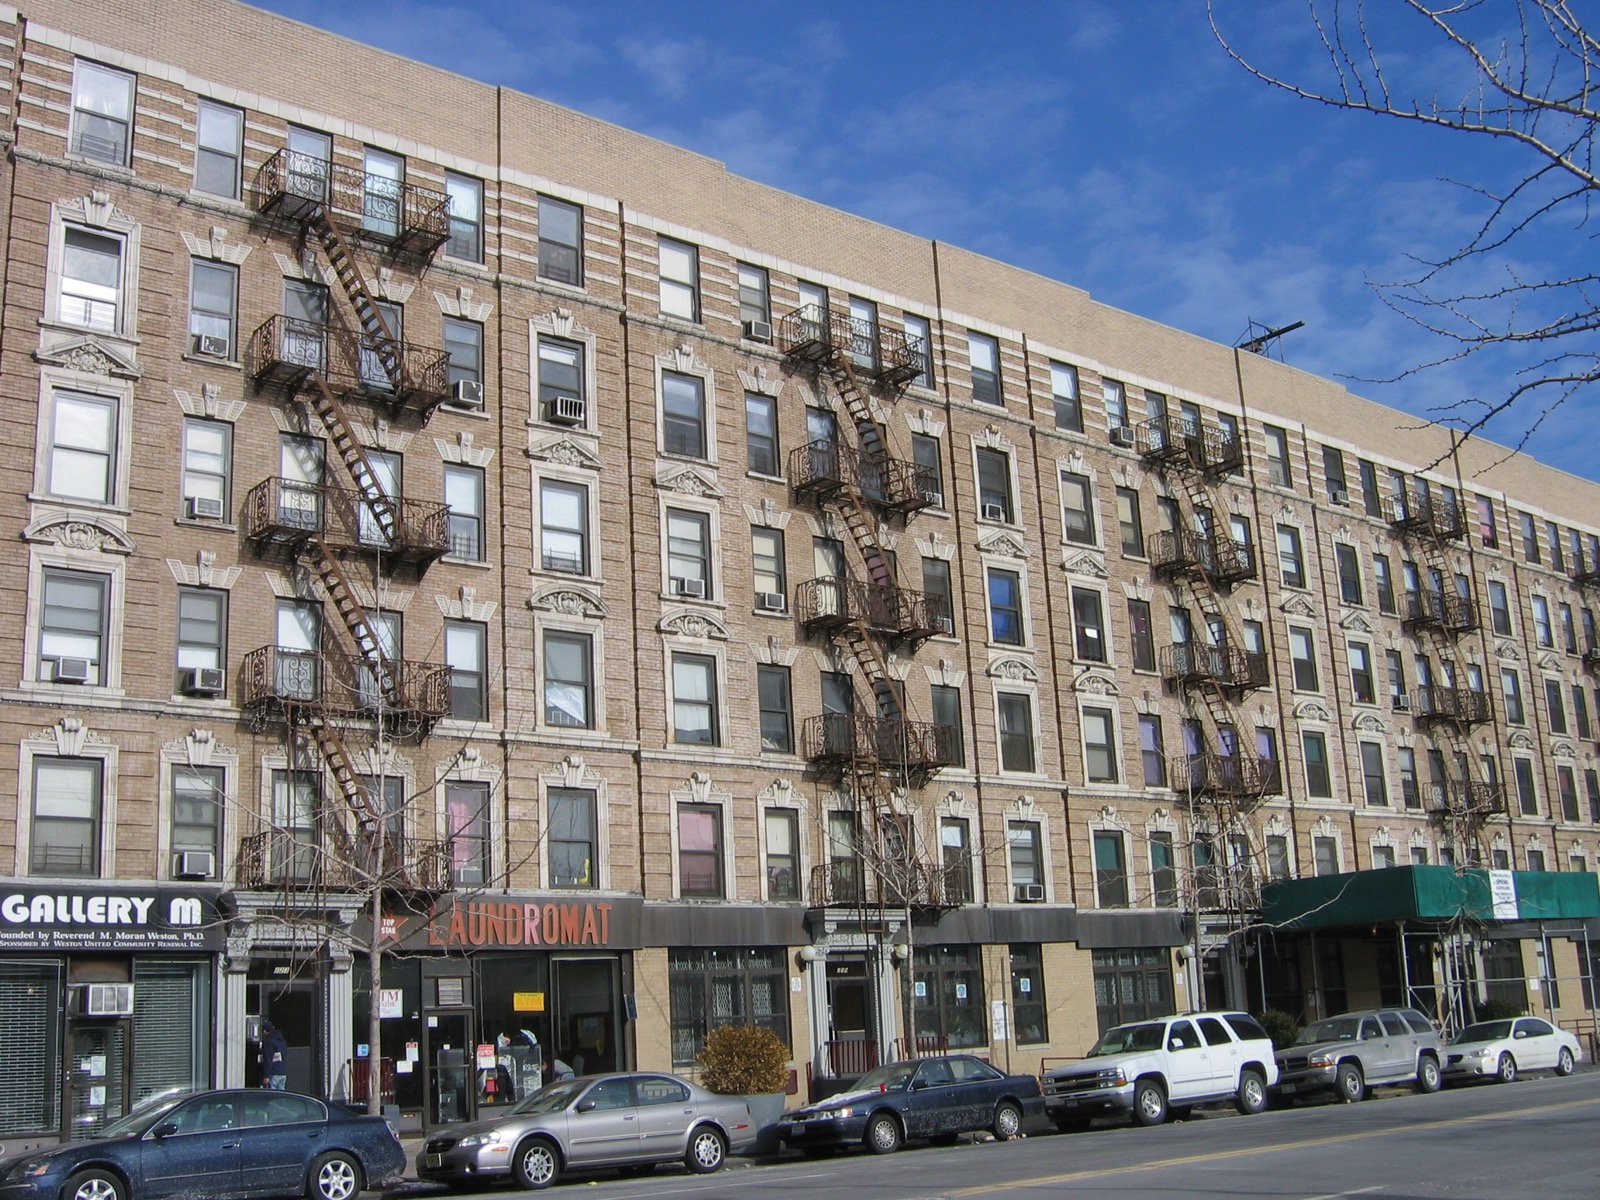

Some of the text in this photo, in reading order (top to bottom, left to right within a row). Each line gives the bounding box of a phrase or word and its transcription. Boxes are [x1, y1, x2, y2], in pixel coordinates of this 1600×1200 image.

[1, 894, 202, 925] GALLERY M
[382, 918, 396, 926] TOP
[428, 902, 612, 946] LAUNDROMAT
[0, 931, 205, 941] ounded by Reverend M. Moran Weston, Ph.D.
[113, 940, 156, 948] COMMUNITY
[157, 940, 189, 948] RENEWAL
[380, 990, 399, 1001] TM
